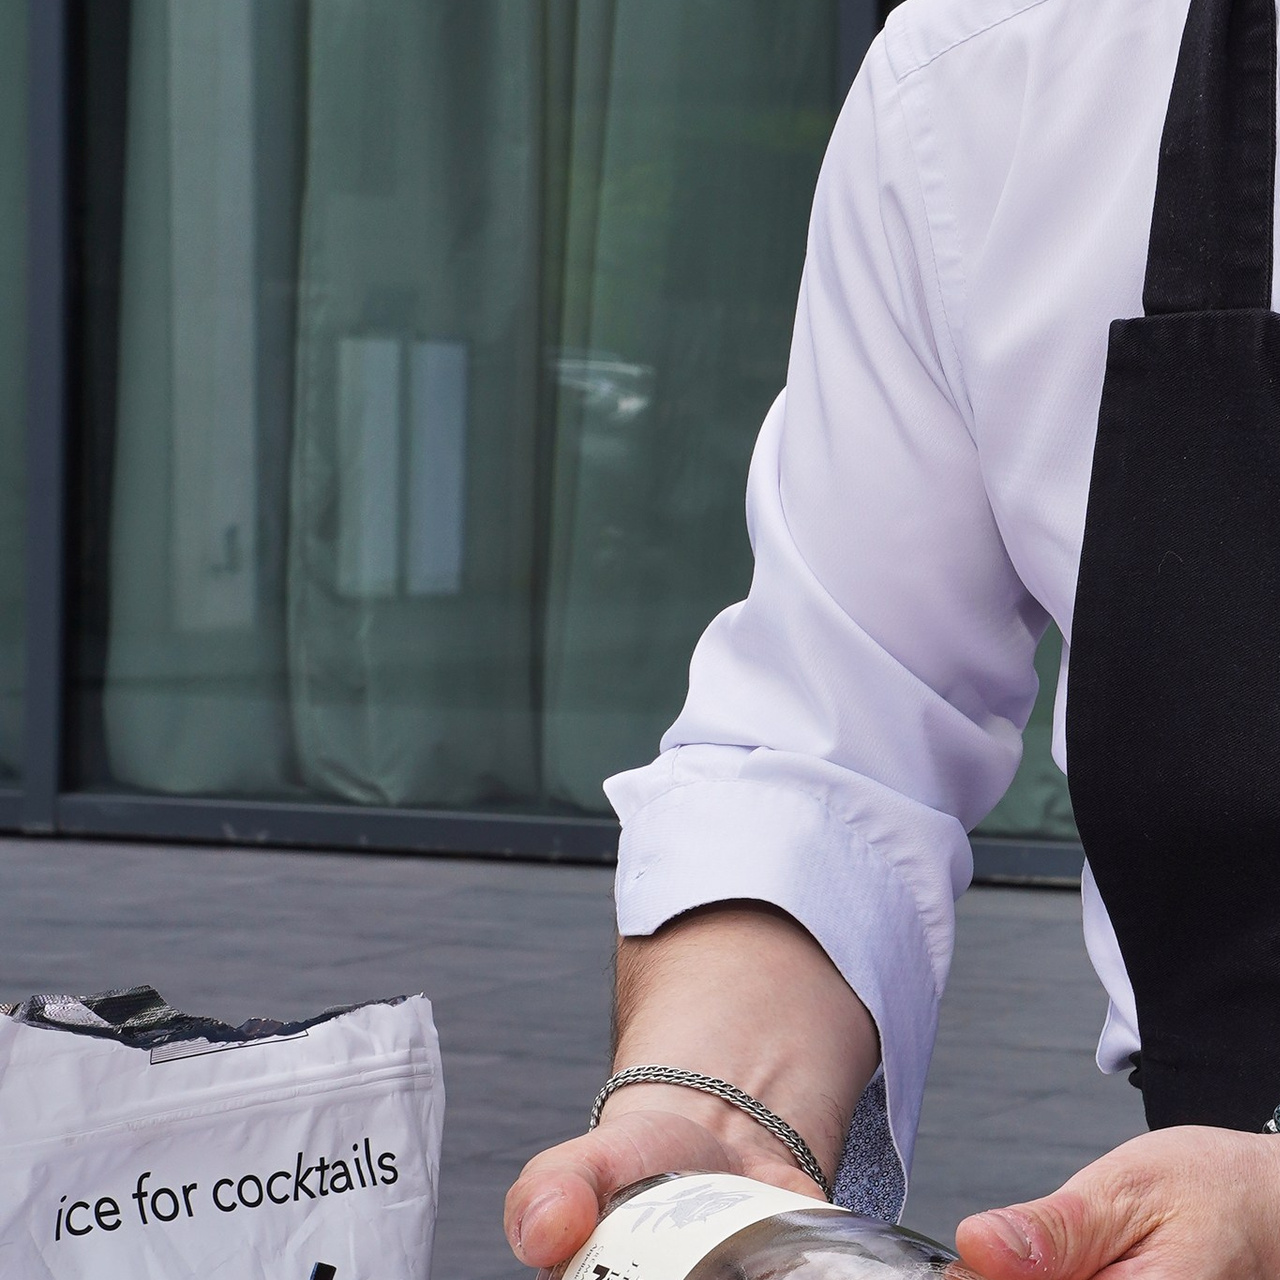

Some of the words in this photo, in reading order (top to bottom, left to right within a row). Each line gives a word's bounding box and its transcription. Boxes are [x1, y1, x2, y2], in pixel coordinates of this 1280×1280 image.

[54, 1194, 123, 1241] ice
[131, 1171, 197, 1225] for
[212, 1137, 399, 1212] cocktails
